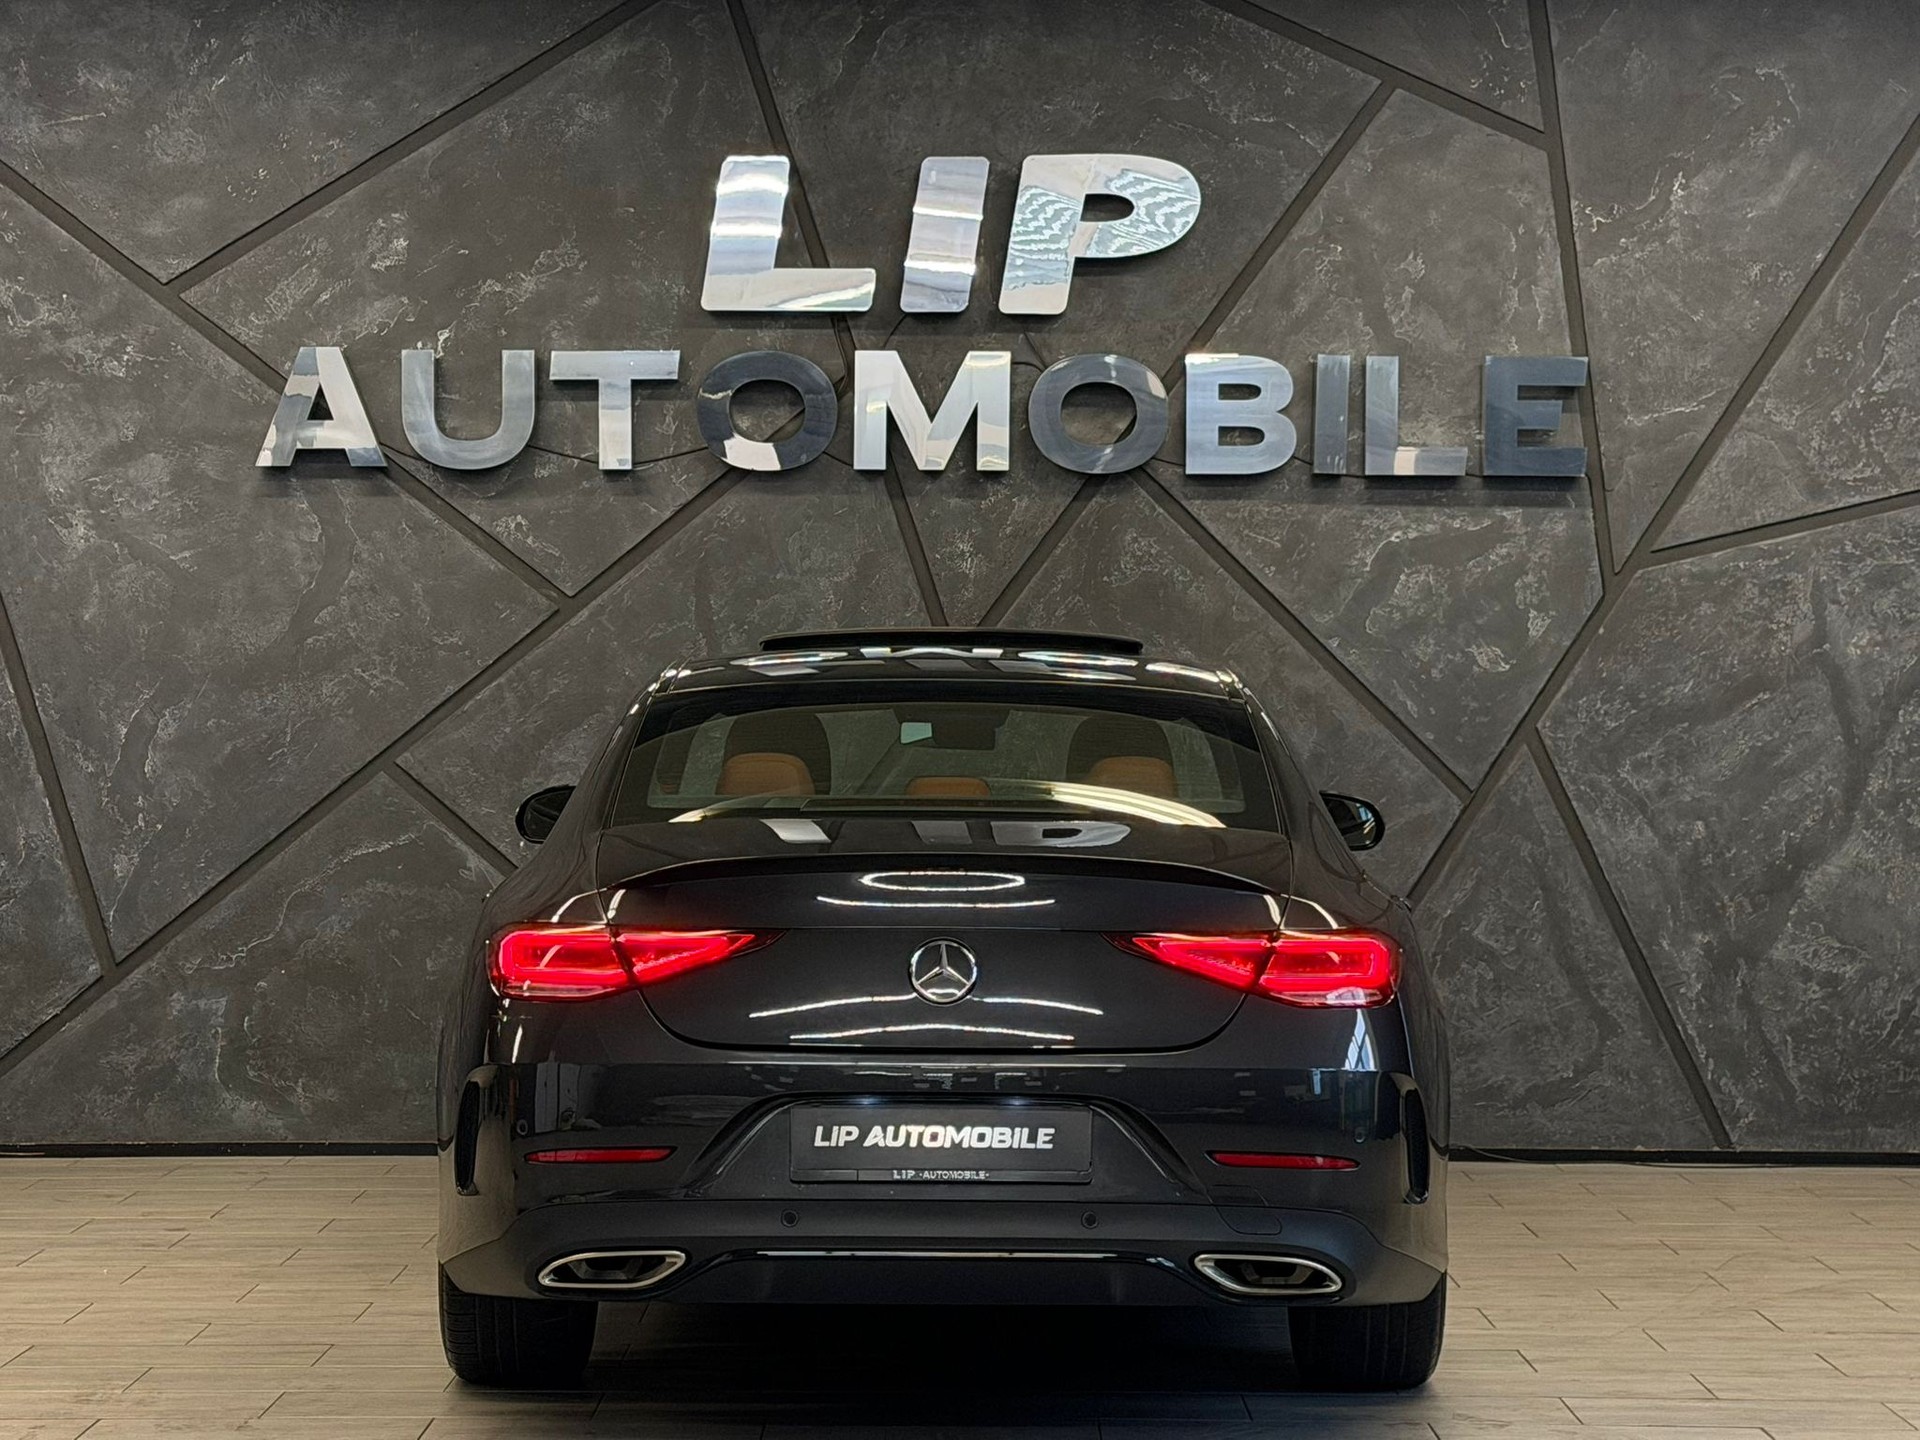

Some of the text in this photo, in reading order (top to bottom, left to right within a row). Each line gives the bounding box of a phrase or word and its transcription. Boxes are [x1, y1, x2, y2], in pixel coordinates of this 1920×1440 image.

[702, 154, 1201, 314] LIP
[256, 346, 1588, 476] AUTOMOBILE
[814, 1125, 1055, 1149] LIP AUTOMOBILE
[892, 1169, 916, 1179] LIP
